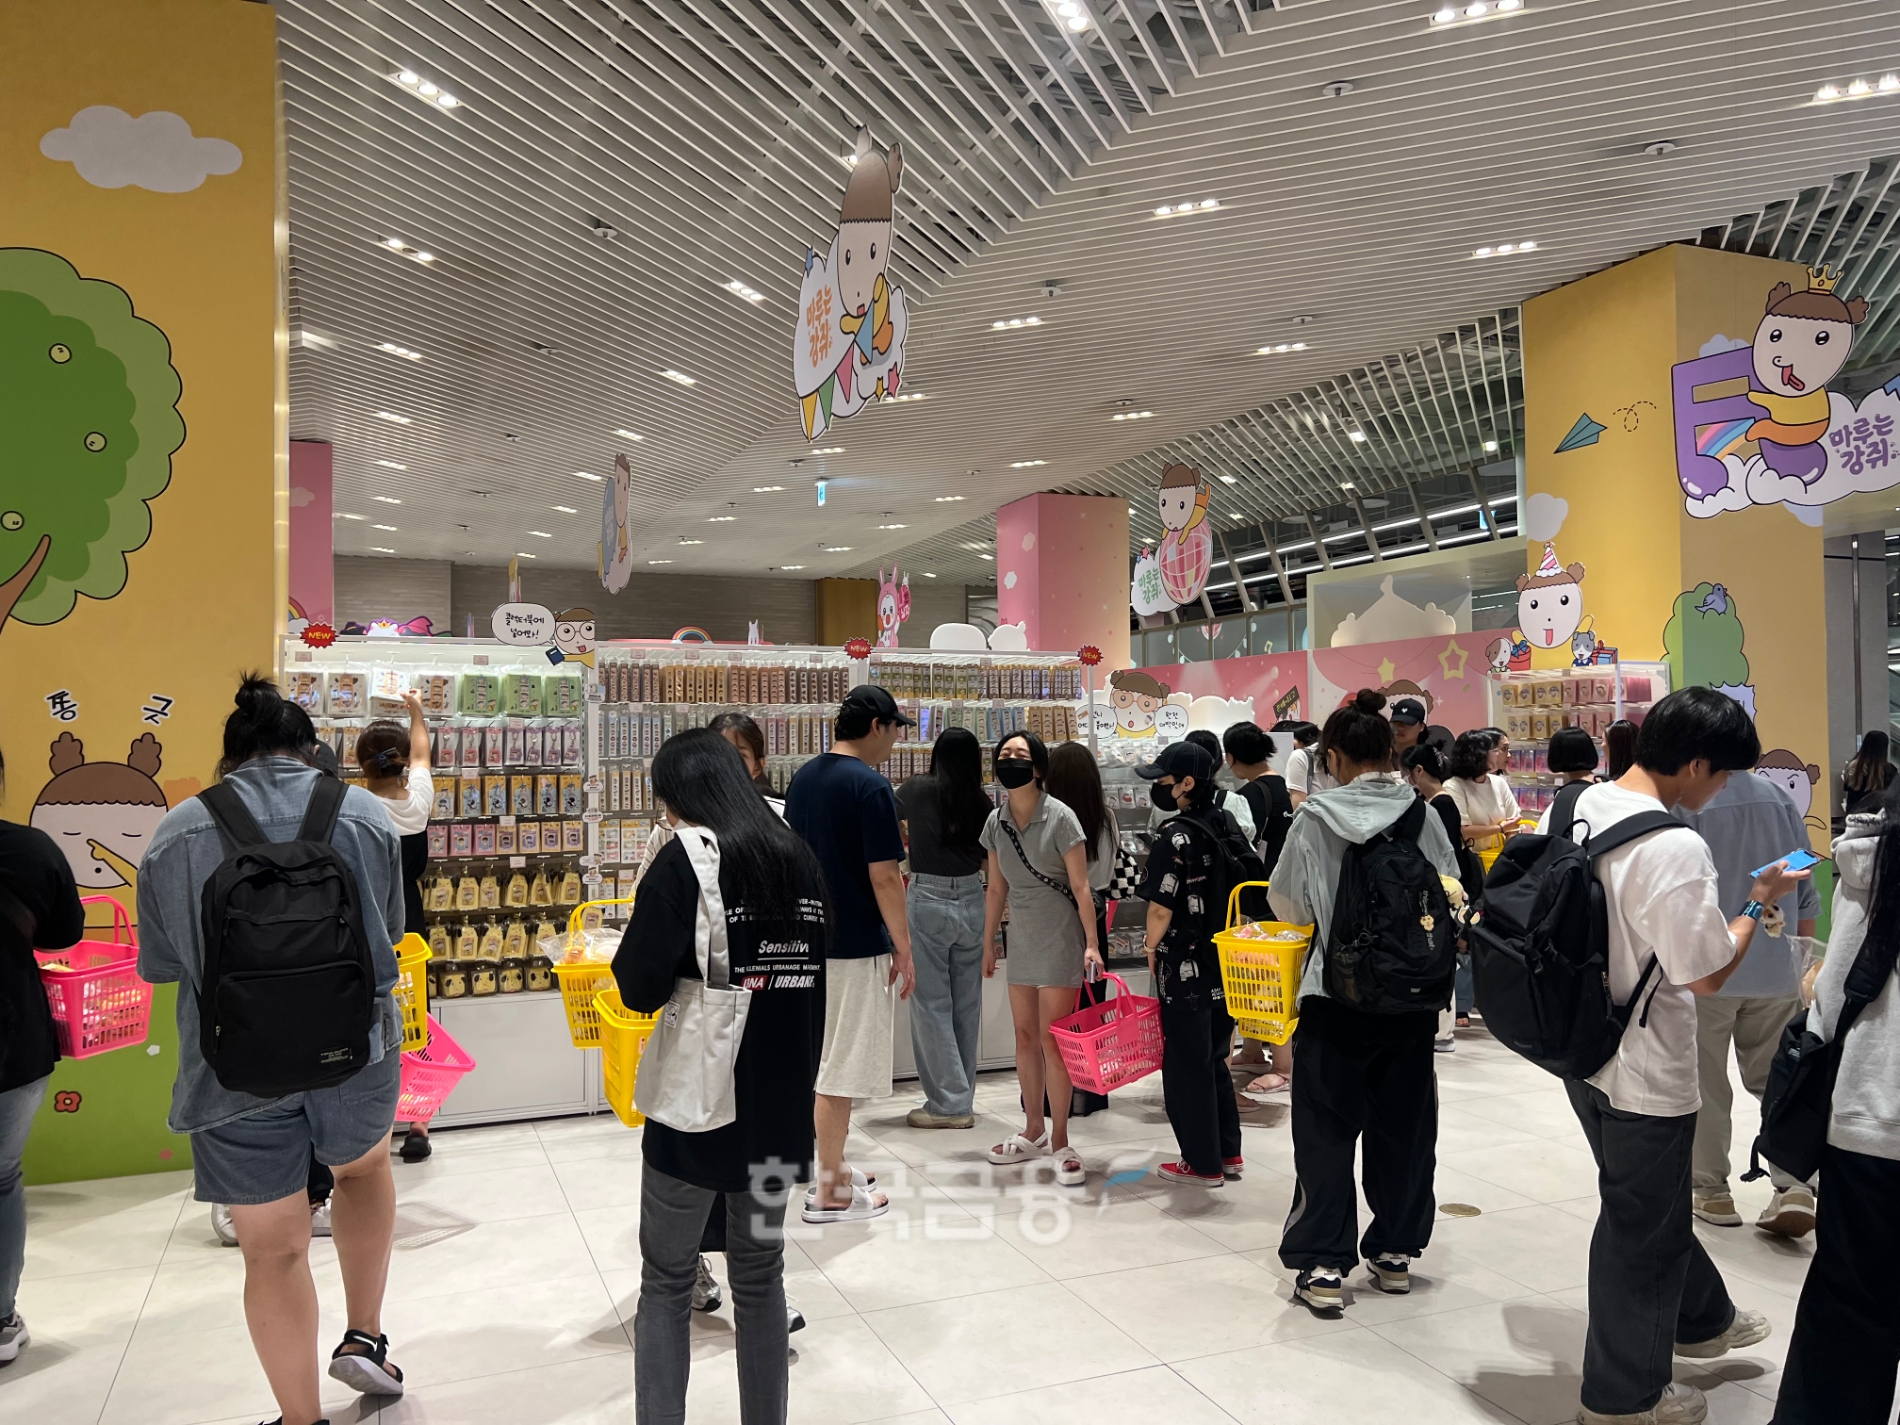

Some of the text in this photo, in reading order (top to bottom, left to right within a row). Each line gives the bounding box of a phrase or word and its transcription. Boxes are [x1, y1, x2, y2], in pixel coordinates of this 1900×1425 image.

[806, 284, 833, 329] 마루는
[809, 318, 829, 368] 강쥐
[1829, 413, 1895, 448] 마루는
[1840, 437, 1889, 475] 강쥐
[1138, 566, 1160, 588] 마루는
[308, 631, 331, 640] NEW
[1083, 652, 1098, 660] NEW
